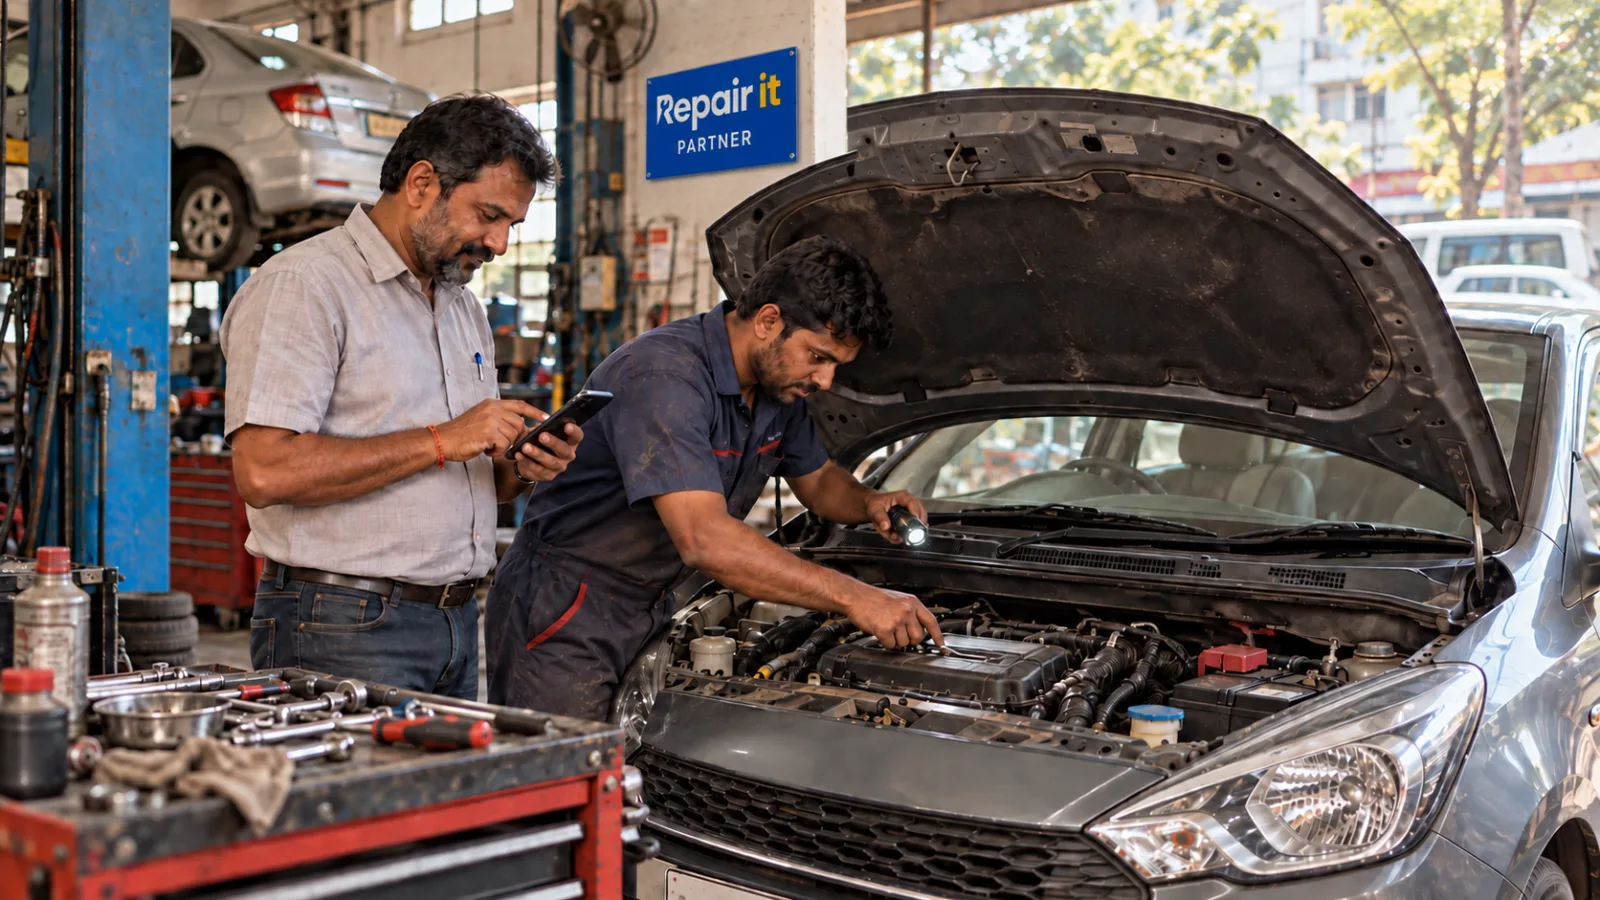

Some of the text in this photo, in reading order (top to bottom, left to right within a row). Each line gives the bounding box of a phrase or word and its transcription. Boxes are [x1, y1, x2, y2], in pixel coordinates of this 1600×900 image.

[656, 72, 781, 131] Repair it
[677, 129, 752, 155] PARTNER
